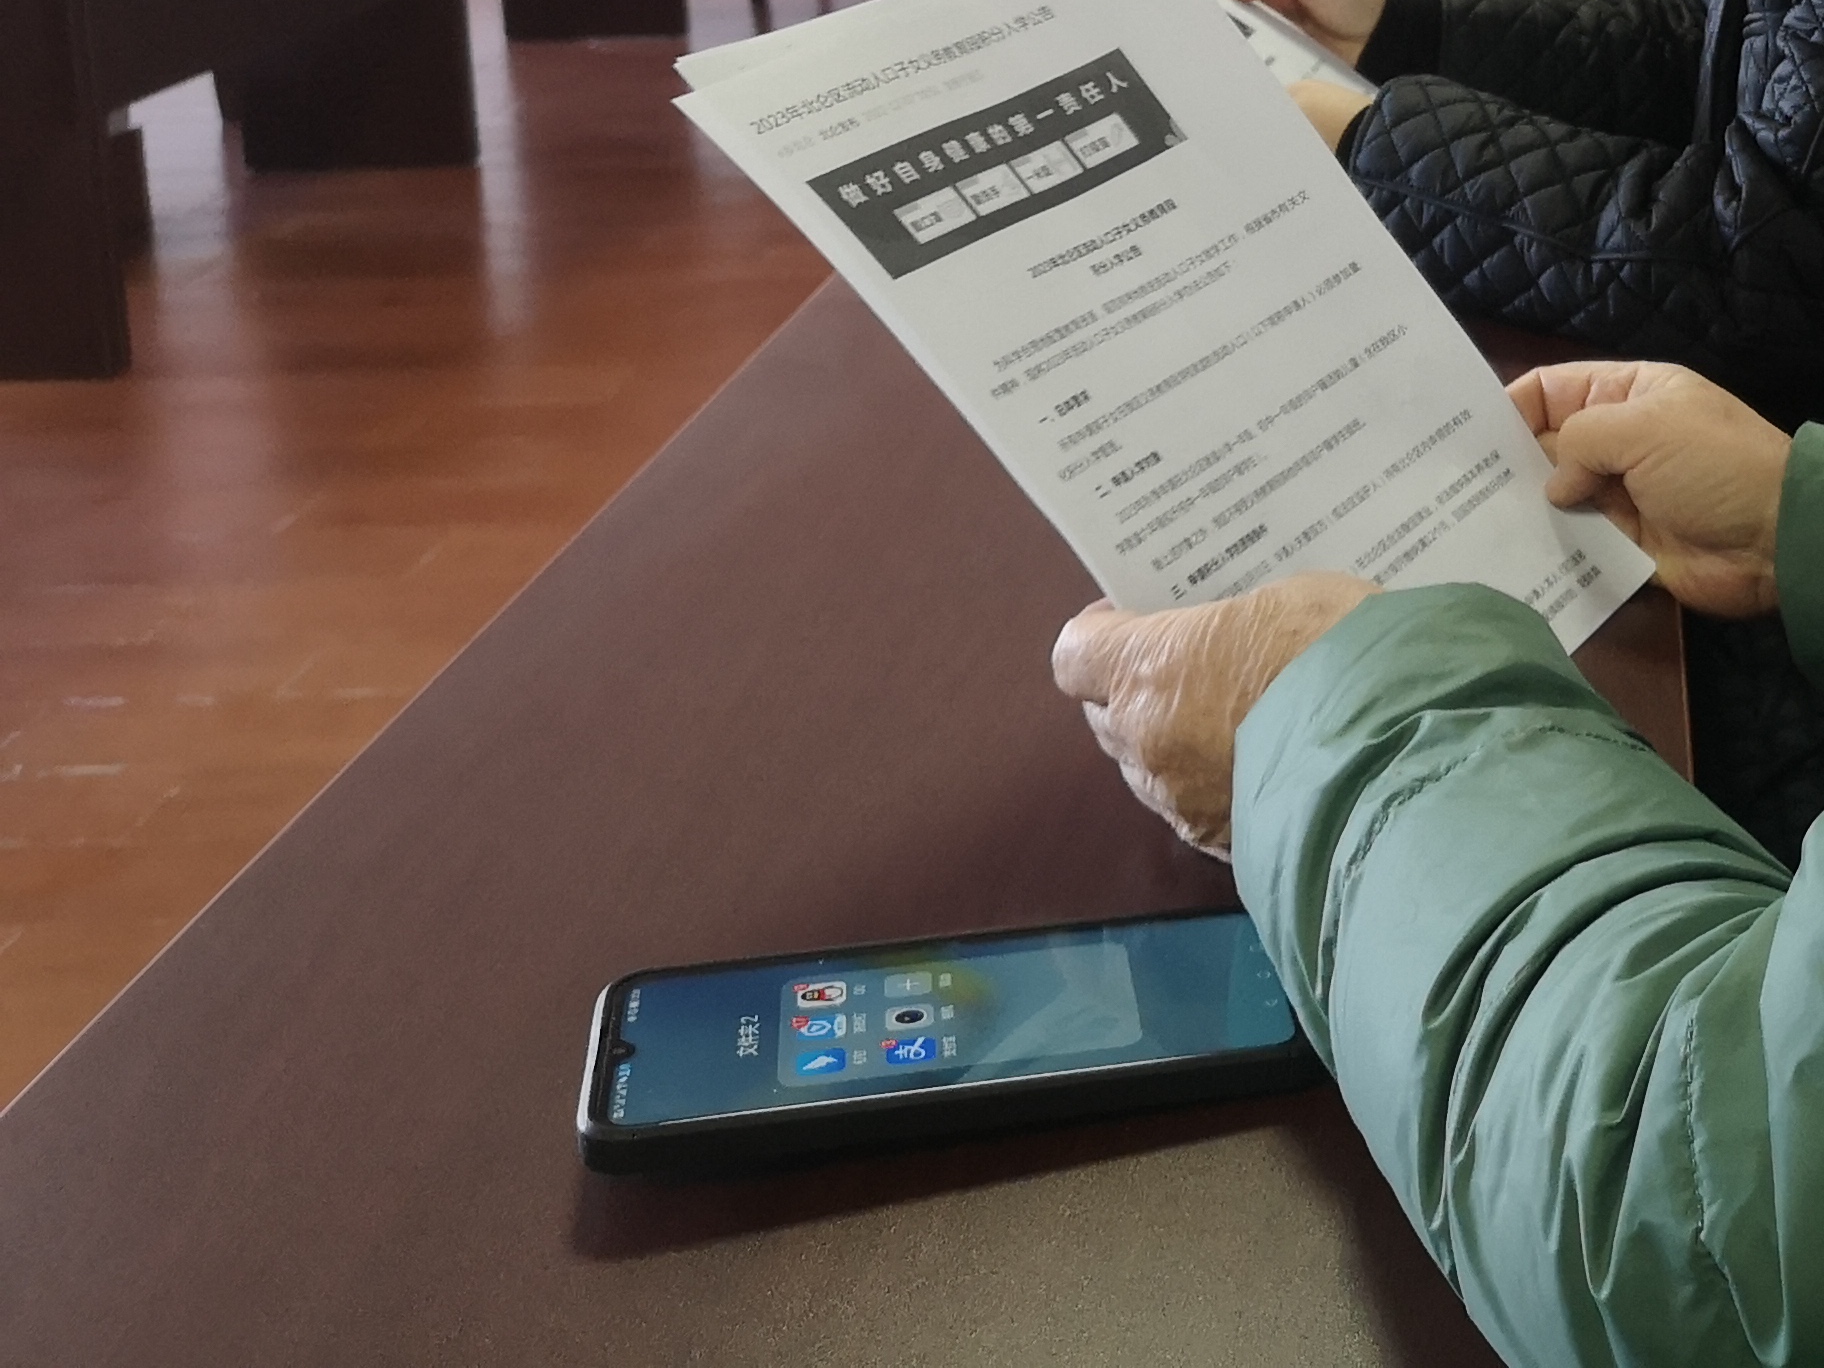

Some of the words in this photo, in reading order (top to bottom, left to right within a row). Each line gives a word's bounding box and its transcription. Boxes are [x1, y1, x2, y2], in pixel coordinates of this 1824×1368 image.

[837, 70, 1129, 209] 做好自身健康的第一责任人
